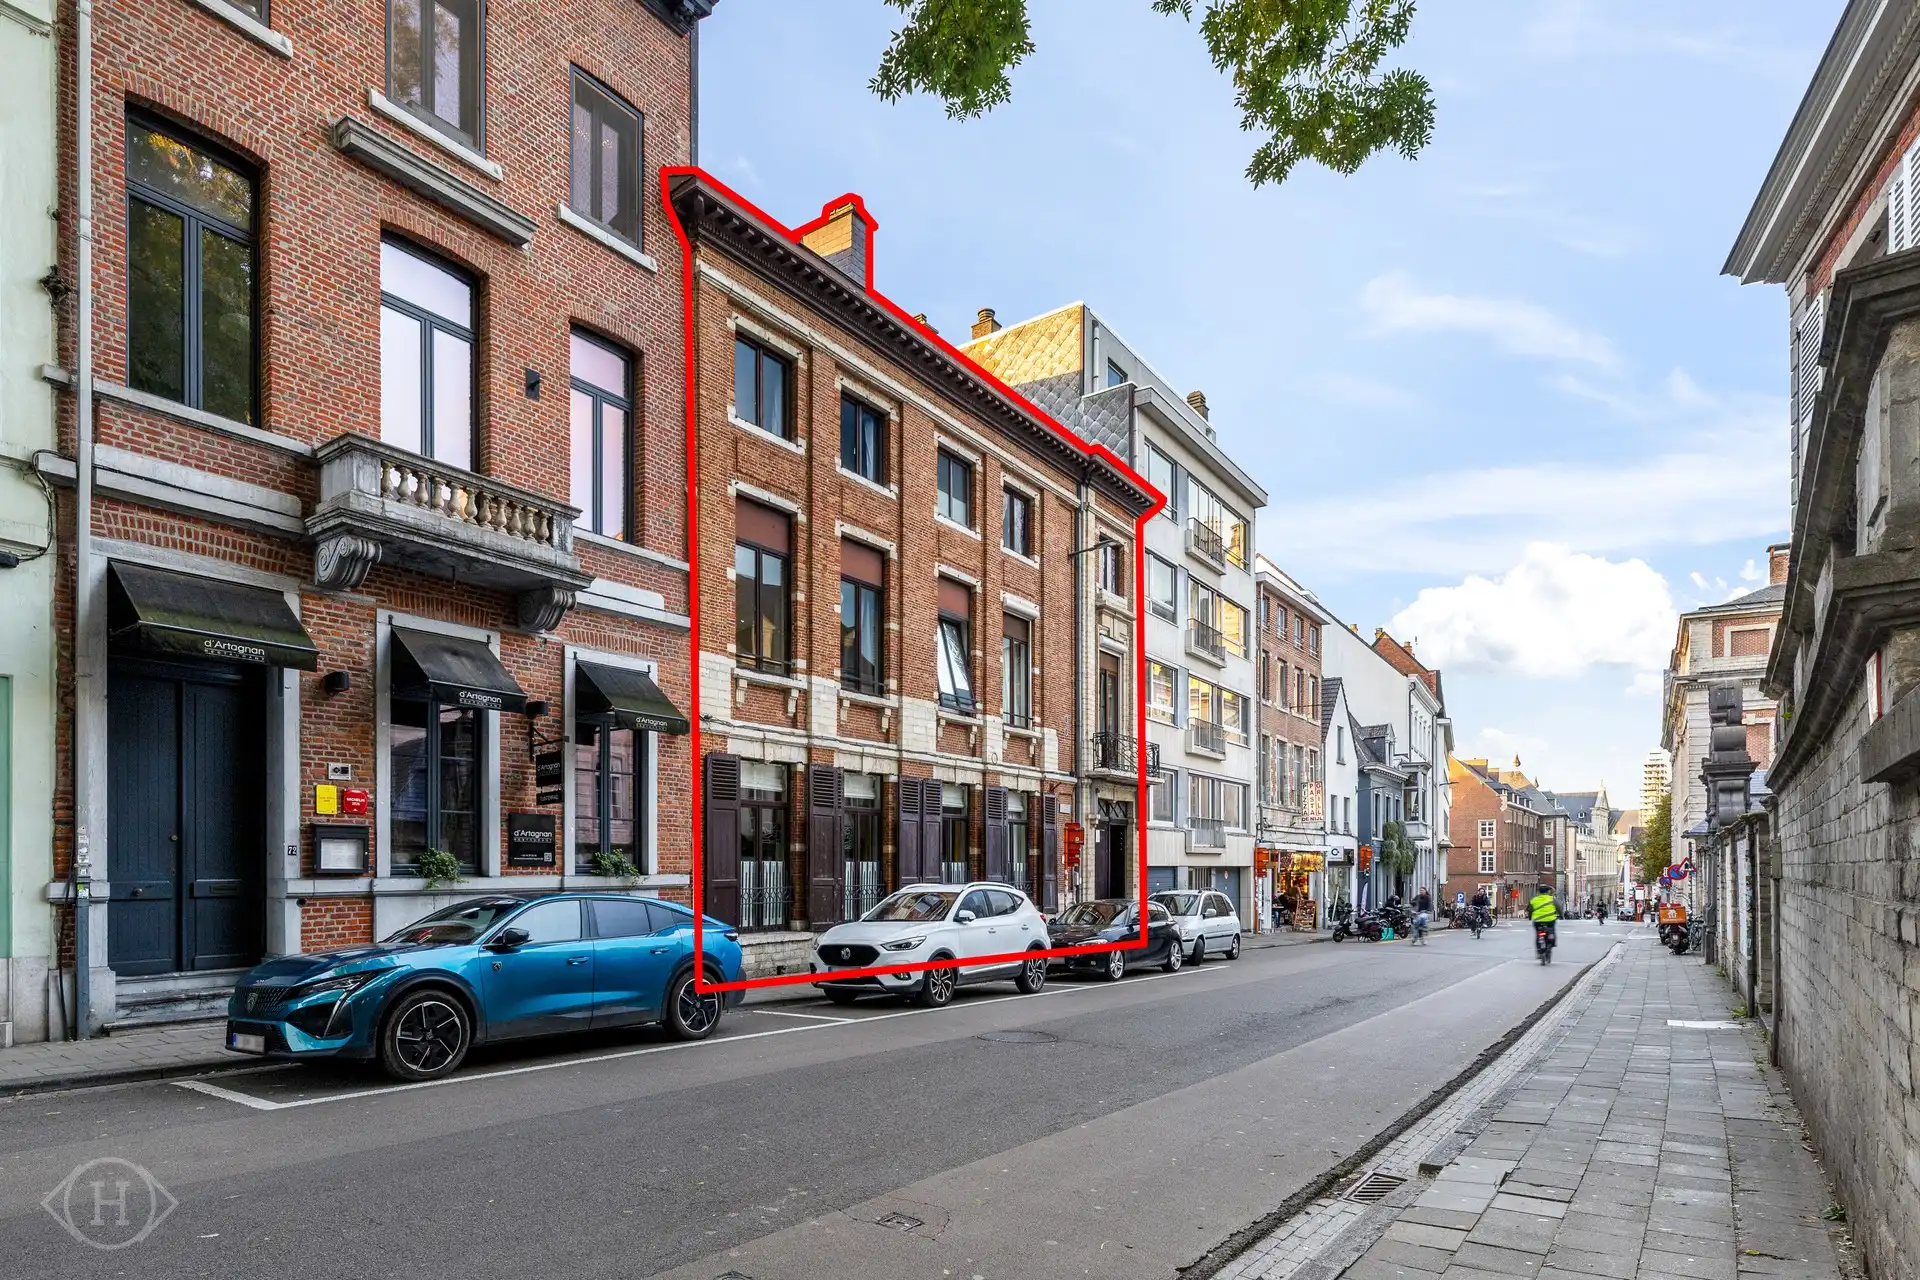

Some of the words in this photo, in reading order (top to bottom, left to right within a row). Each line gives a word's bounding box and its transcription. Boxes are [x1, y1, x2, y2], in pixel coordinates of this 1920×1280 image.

[204, 640, 265, 656] d'Artagnan
[459, 691, 502, 703] d'Artagnan
[513, 830, 553, 839] d'Artagnan
[288, 846, 297, 855] 72
[1457, 893, 1464, 902] P
